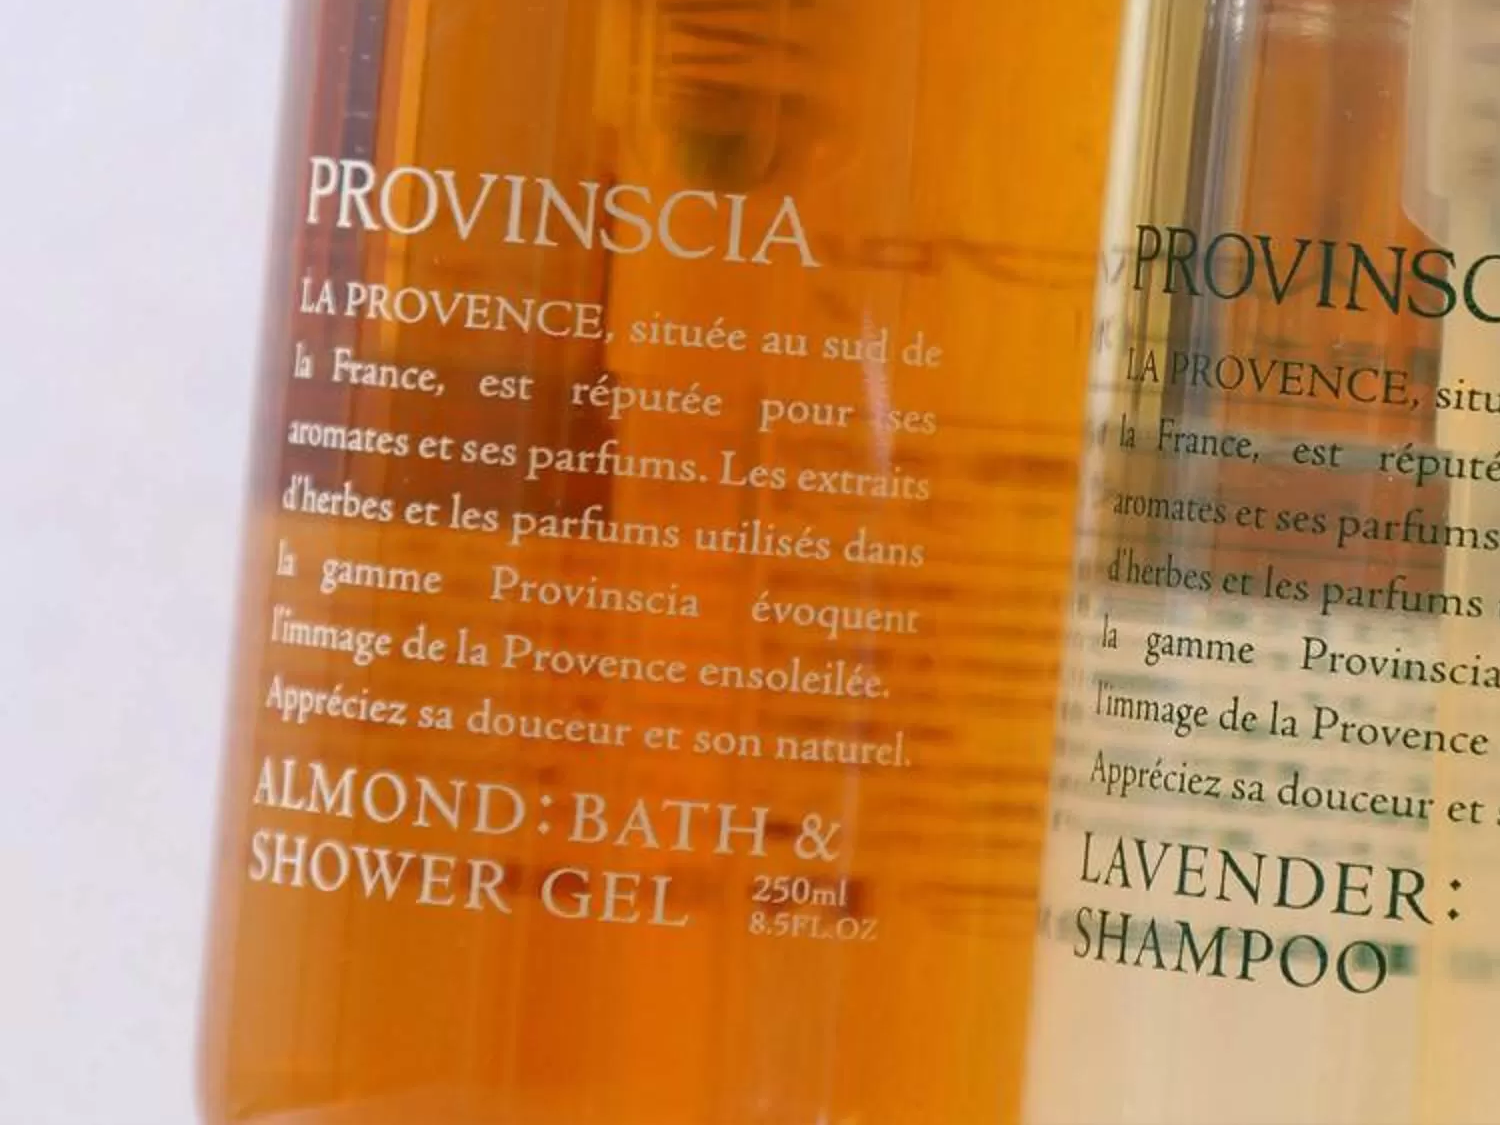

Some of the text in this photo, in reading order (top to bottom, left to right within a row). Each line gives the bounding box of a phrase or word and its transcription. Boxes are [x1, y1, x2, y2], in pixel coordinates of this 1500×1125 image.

[307, 155, 824, 268] PROVINSCIA
[300, 277, 942, 368] LA PROVENCE, située au sud de
[294, 343, 937, 436] la France, est réputée pour ses
[1126, 346, 1160, 385] LA
[1170, 350, 1420, 411] PROVENCE,
[288, 419, 931, 502] aromates et ses parfums. Les extraits
[1119, 413, 1136, 449] la
[1158, 418, 1260, 463] France,
[1293, 440, 1343, 469] est
[405, 501, 439, 526] et
[450, 496, 499, 532] les
[511, 505, 680, 549] parfums
[696, 521, 831, 562] utilisés
[844, 530, 925, 568] dans
[1113, 488, 1227, 525] aromates
[1235, 504, 1267, 530] et
[1276, 507, 1327, 536] ses
[277, 539, 918, 637] la gamme Provinscia évoquent
[1222, 569, 1251, 596] et
[1264, 566, 1309, 603] les
[1321, 575, 1484, 619] parfums
[403, 626, 444, 660] de
[457, 630, 488, 667] la
[502, 635, 686, 684] Provence
[700, 661, 891, 701] ensoleilée.
[1102, 616, 1118, 651] la
[1145, 630, 1255, 667] gamme
[266, 675, 912, 769] Appréciez sa douceur et son naturel.
[1219, 696, 1257, 733] de
[1269, 702, 1298, 738] la
[1312, 705, 1488, 758] Provence
[1090, 750, 1221, 799] Appréciez
[1232, 777, 1266, 804] sa
[1277, 773, 1435, 820] douceur
[1447, 798, 1484, 825] et
[570, 792, 770, 857] BATH
[792, 812, 842, 862] &
[250, 831, 689, 928] SHOWER GEL
[751, 875, 848, 907] 250ml
[1072, 905, 1389, 996] SHAMPOO
